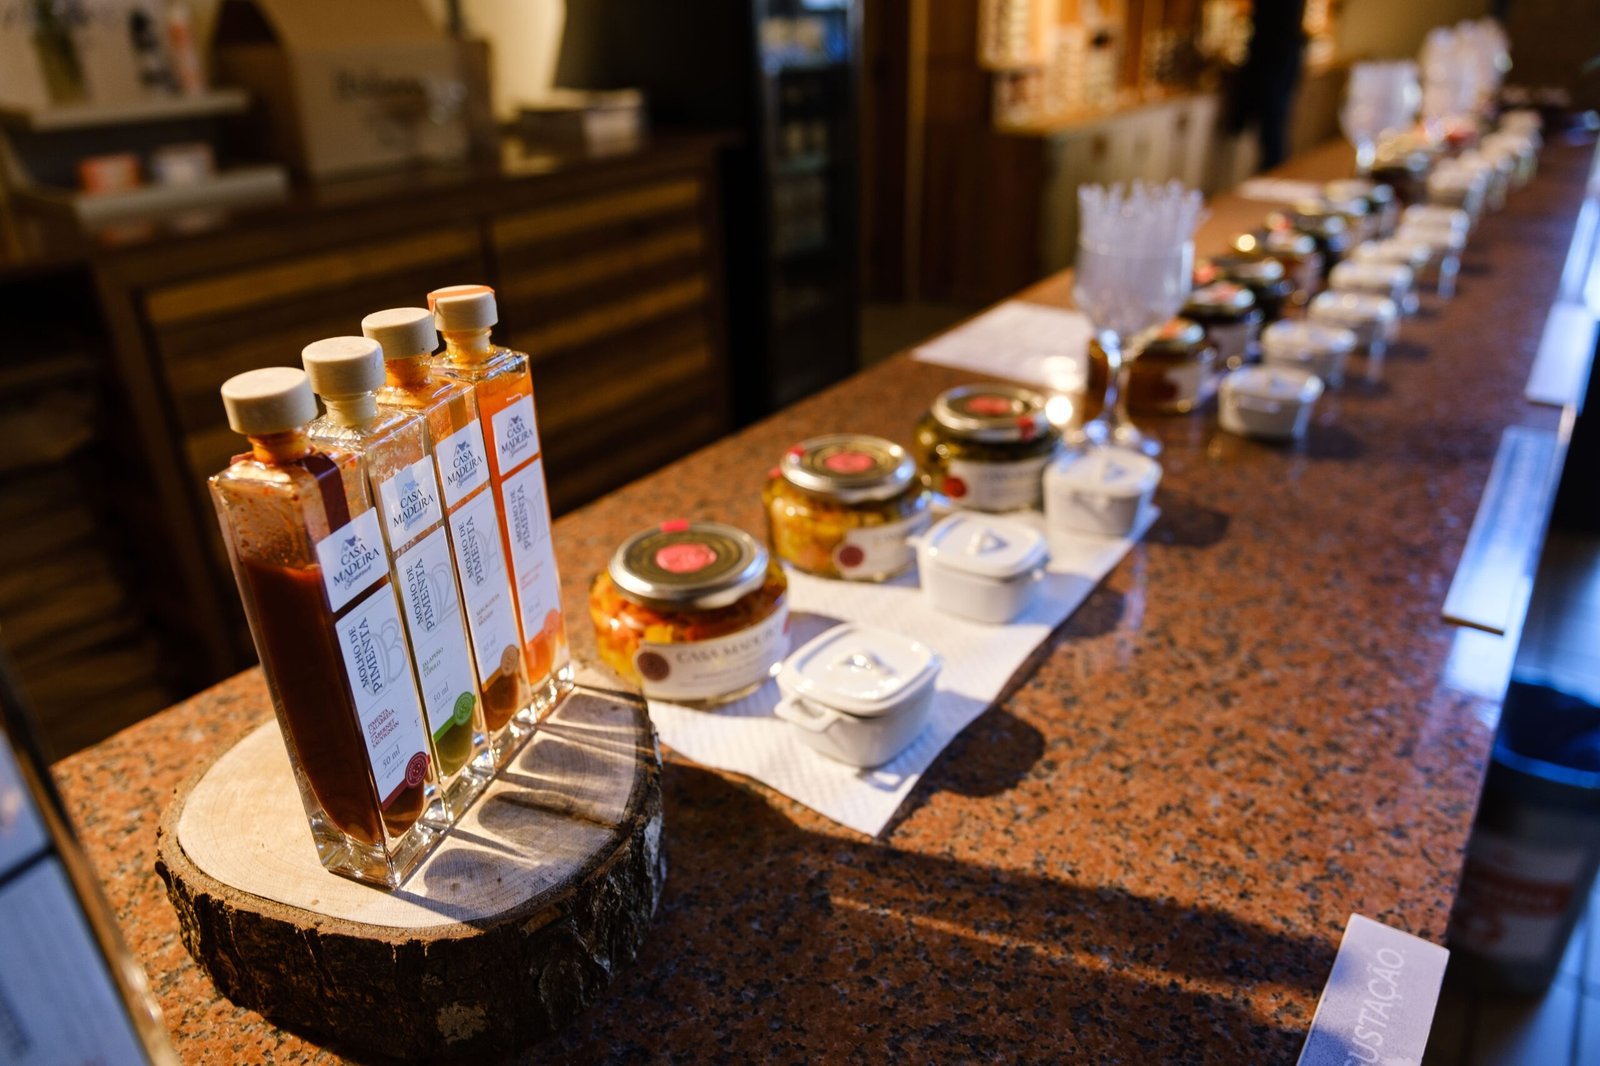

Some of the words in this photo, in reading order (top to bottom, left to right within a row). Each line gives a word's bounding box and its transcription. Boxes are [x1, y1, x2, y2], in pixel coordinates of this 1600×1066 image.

[501, 429, 533, 454] MADEIRA
[506, 421, 525, 439] CASA
[447, 456, 482, 486] MADEIRA
[453, 450, 473, 469] CASA
[393, 494, 434, 528] MADEIRA
[400, 489, 423, 509] CASA
[458, 521, 466, 538] DE
[341, 543, 367, 566] CASA
[462, 539, 473, 579] MOLHO
[466, 516, 484, 586] PIMENTA
[333, 548, 380, 586] MADEIRA
[406, 565, 415, 582] DE
[410, 584, 424, 625] MOLHO
[415, 557, 435, 632] PIMENTA
[348, 626, 358, 644] DE
[353, 644, 369, 688] MOLHO
[358, 617, 383, 694] PIMENTA
[371, 718, 396, 743] CABERNET
[372, 721, 399, 748] SAUVIGNON
[383, 756, 392, 768] 50
[392, 744, 400, 759] ml
[1343, 948, 1405, 1066] USTAÇÃO
